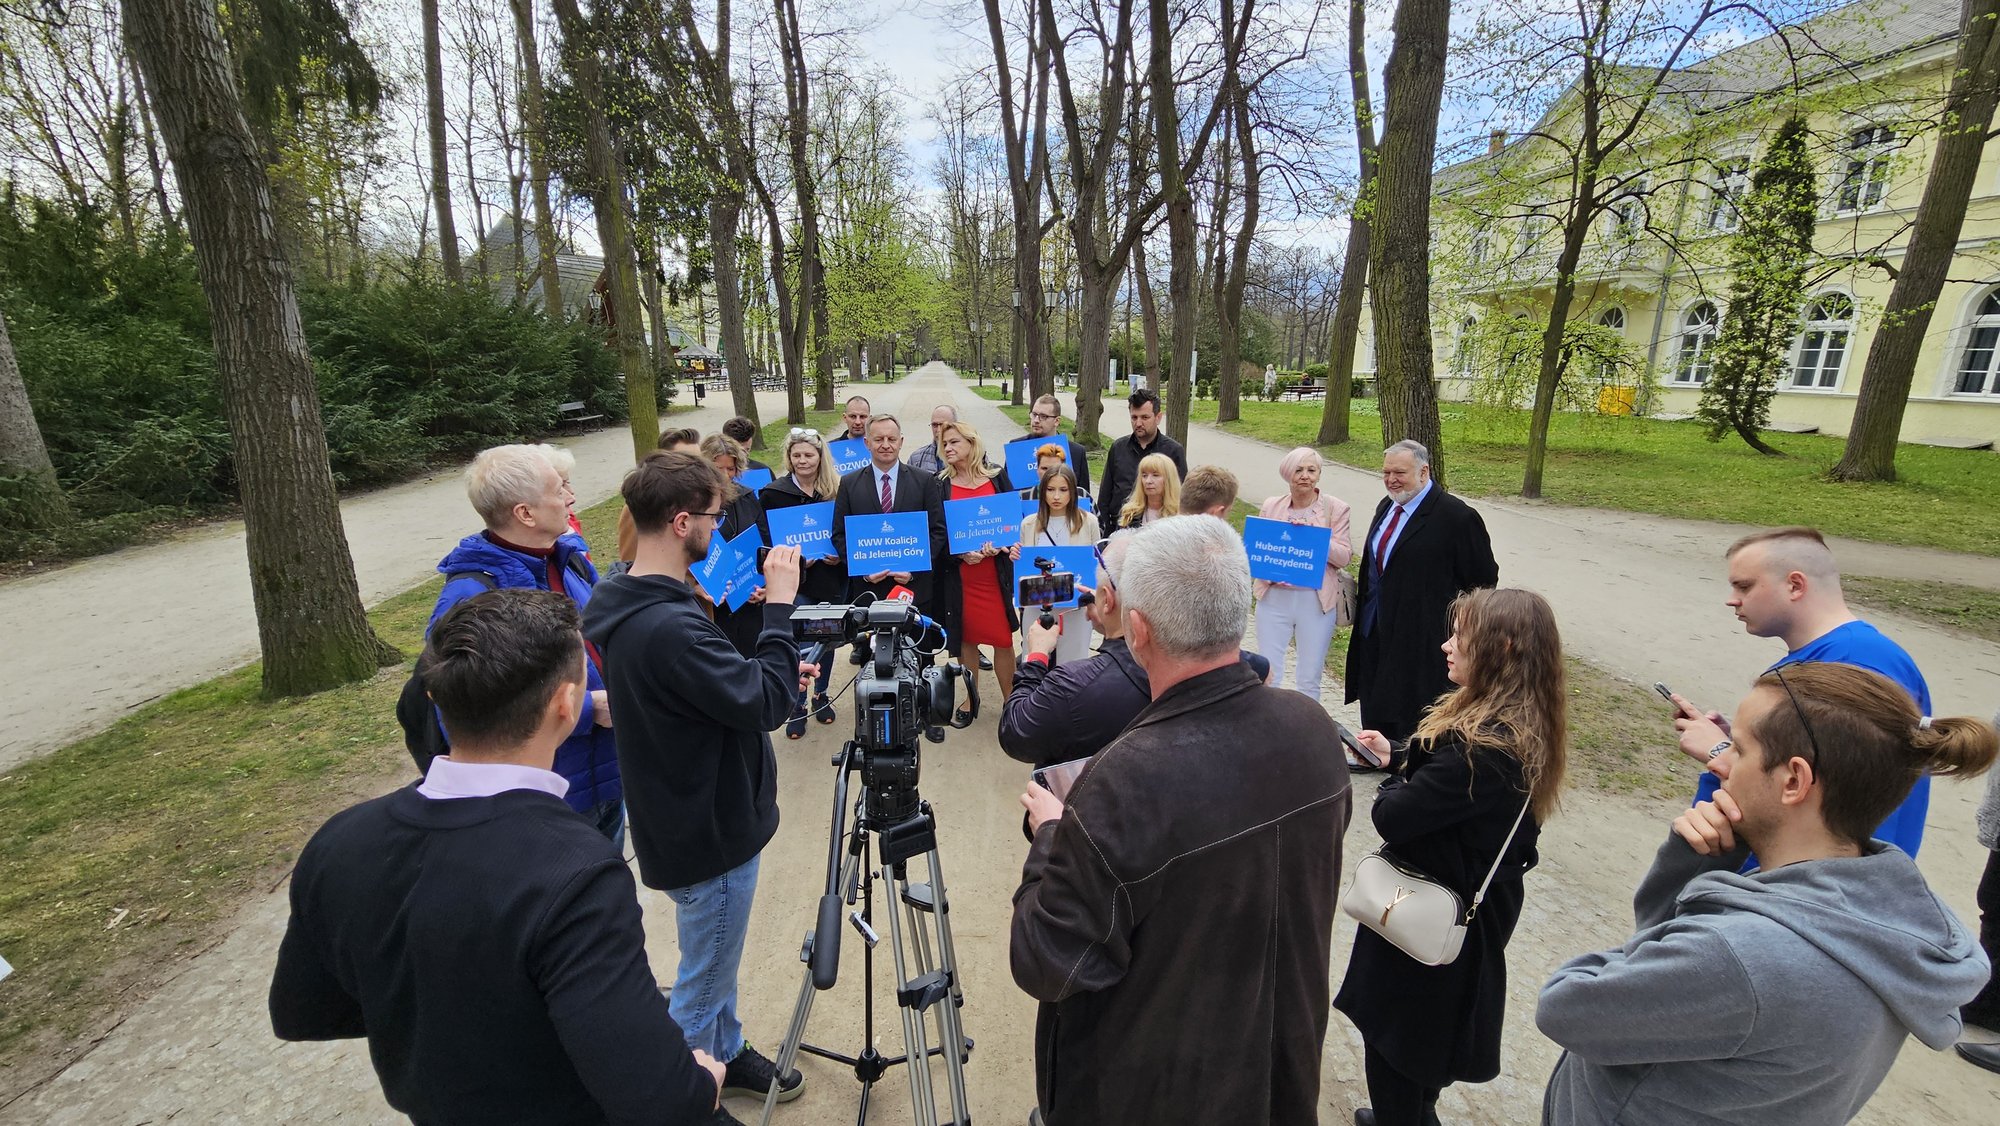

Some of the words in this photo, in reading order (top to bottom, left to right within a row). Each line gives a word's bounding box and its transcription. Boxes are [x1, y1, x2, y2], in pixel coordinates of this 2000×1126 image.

[975, 516, 1002, 525] sercem
[786, 529, 832, 545] KULTUR
[954, 530, 966, 539] dla
[968, 528, 995, 539] Jeleniej
[858, 537, 882, 547] KWW
[885, 536, 918, 546] Koalicja
[853, 551, 867, 560] dla
[869, 549, 902, 559] Jeleniej
[903, 548, 925, 557] Góry
[1255, 541, 1287, 553] Hubert
[1288, 546, 1314, 559] Papaj
[1251, 554, 1262, 562] na
[1263, 555, 1314, 571] Prezydenta
